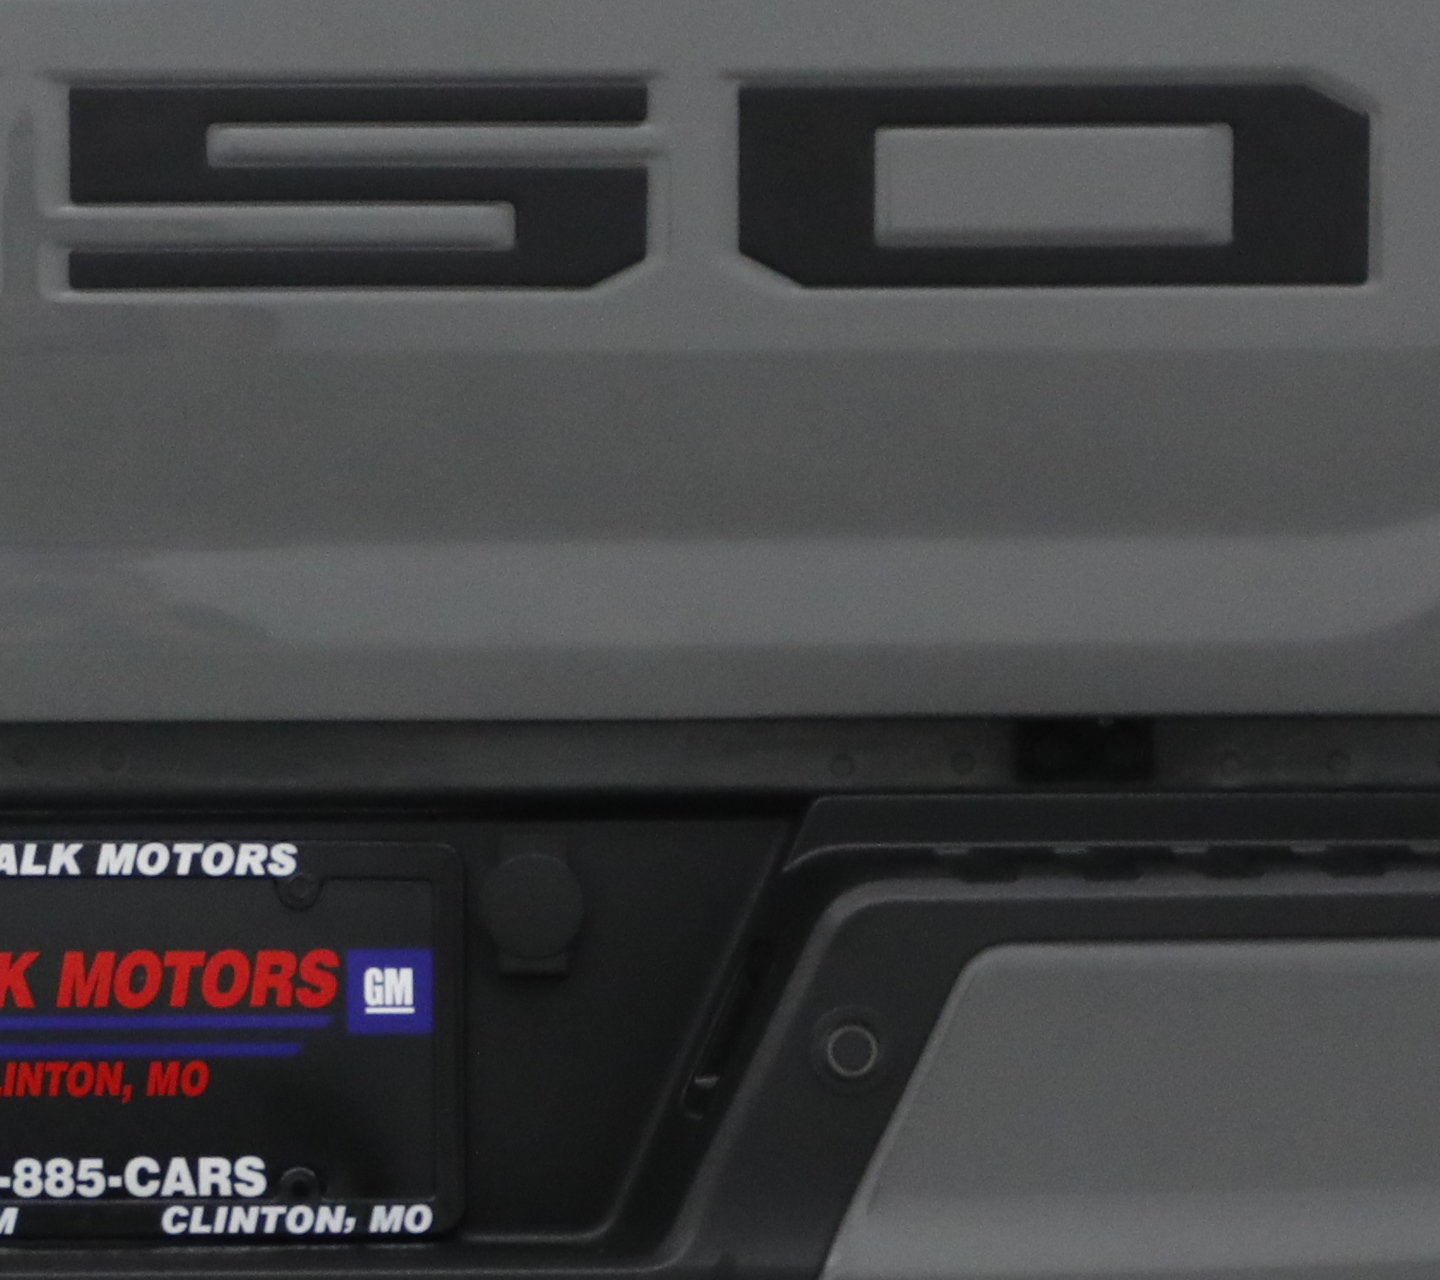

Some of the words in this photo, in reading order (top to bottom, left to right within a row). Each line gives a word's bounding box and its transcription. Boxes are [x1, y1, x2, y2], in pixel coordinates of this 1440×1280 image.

[95, 841, 298, 877] MOTORS
[55, 947, 341, 1010] MOTORS
[363, 966, 416, 1008] GM
[146, 1059, 211, 1097] MO
[161, 1204, 357, 1235] CLINTON,
[369, 1203, 433, 1234] MO
